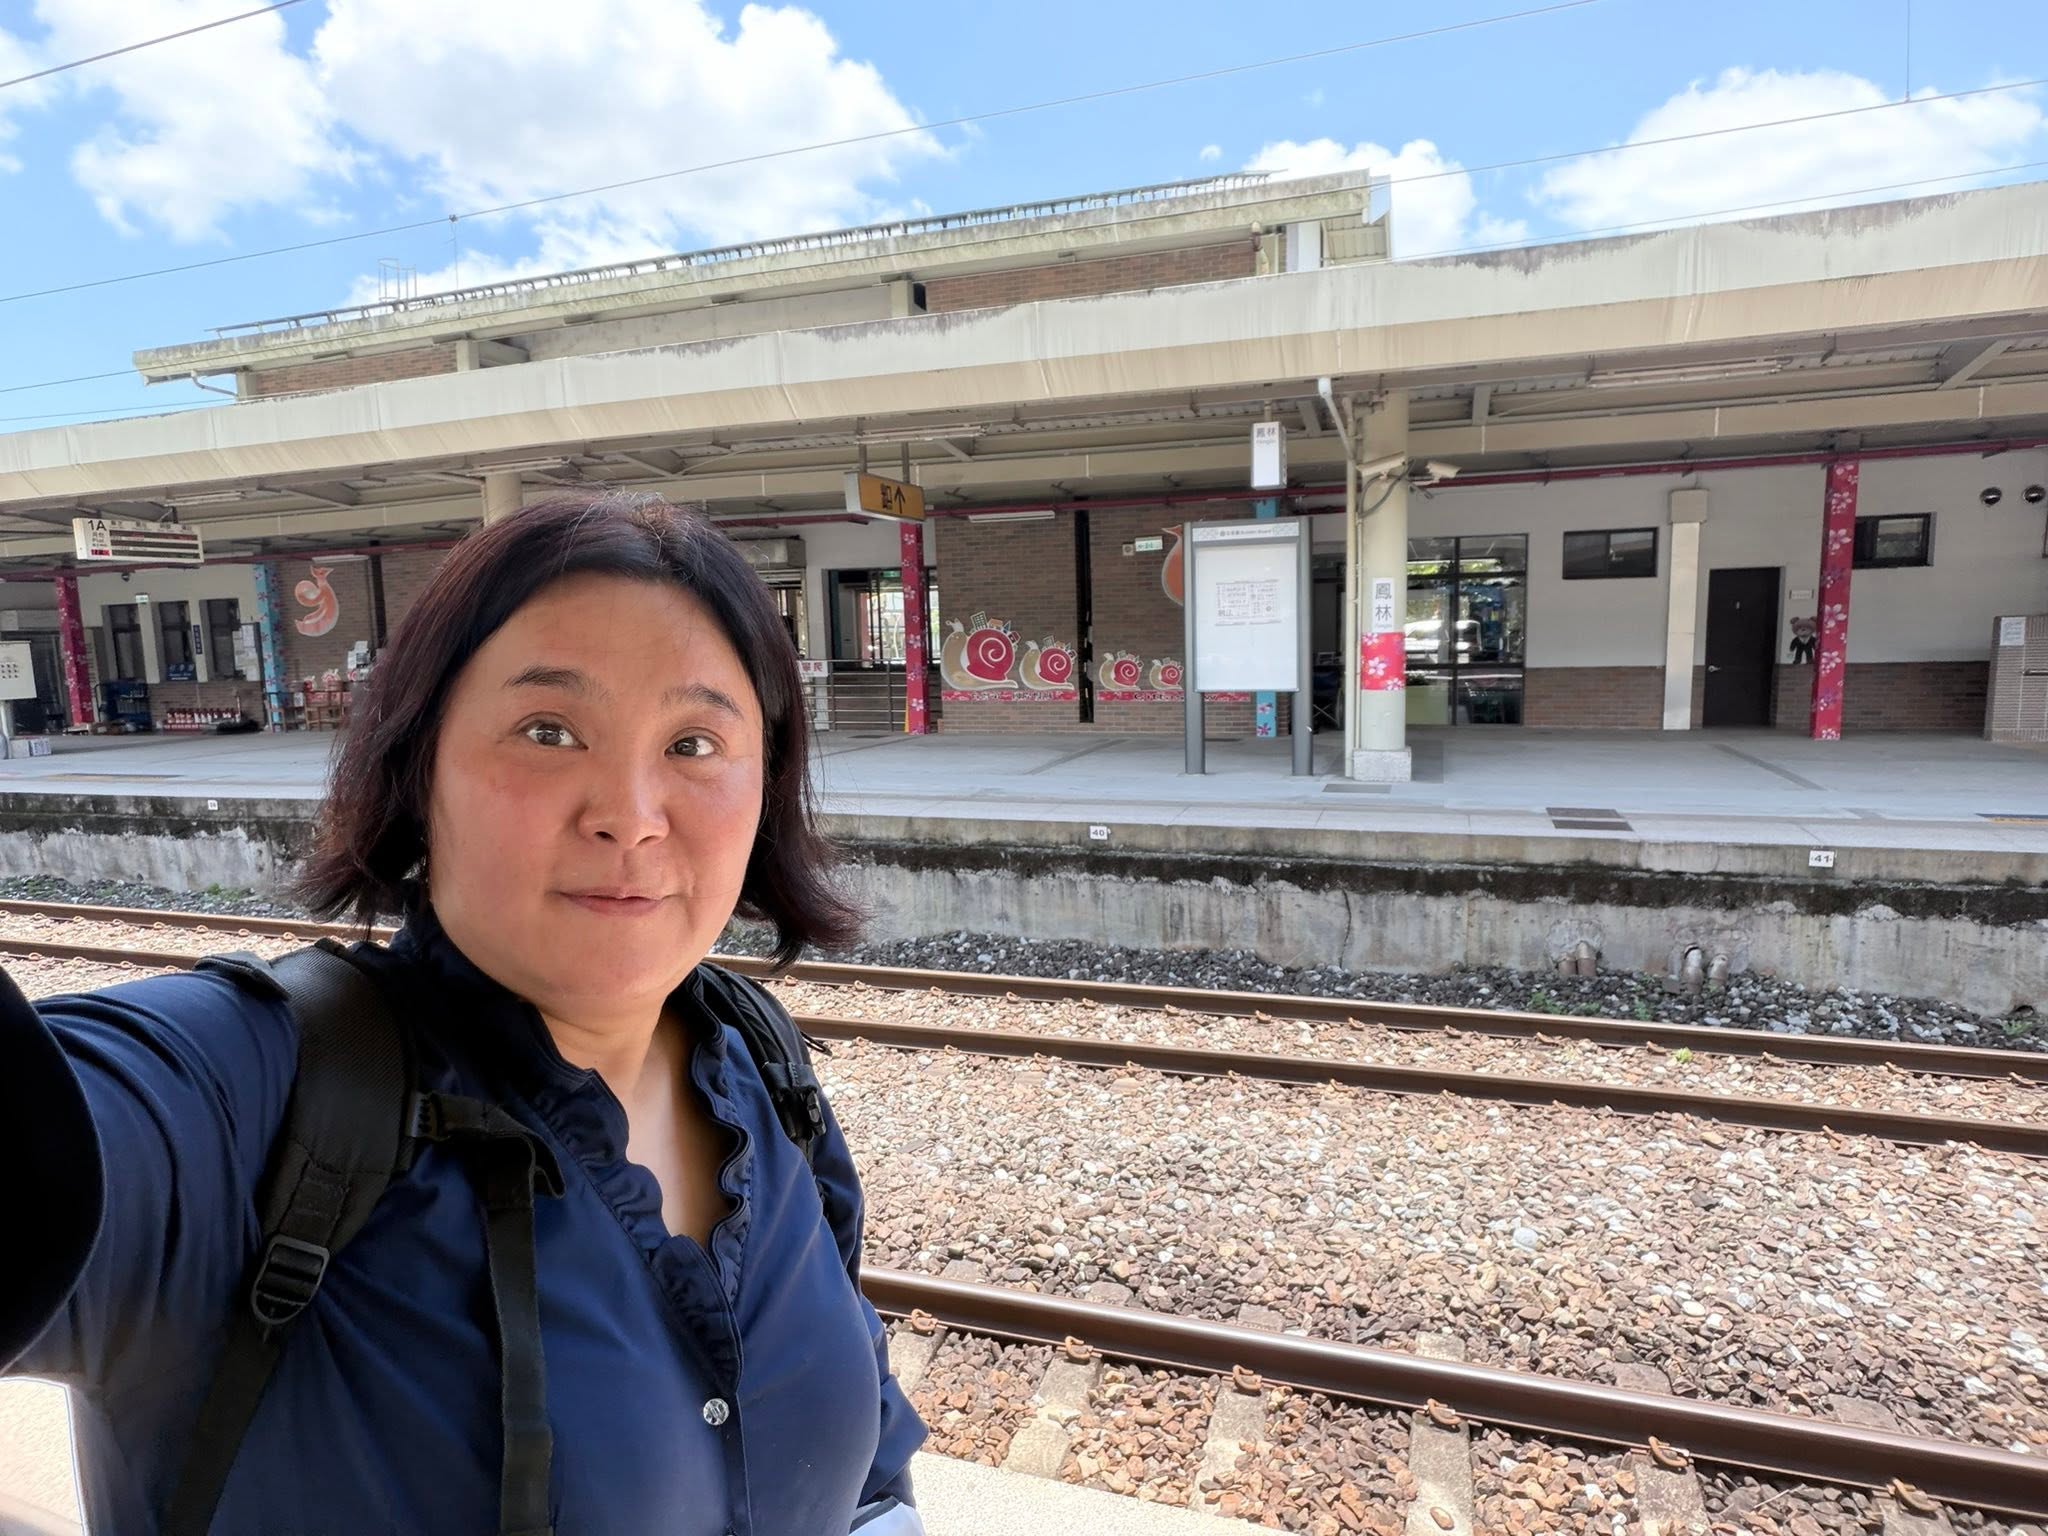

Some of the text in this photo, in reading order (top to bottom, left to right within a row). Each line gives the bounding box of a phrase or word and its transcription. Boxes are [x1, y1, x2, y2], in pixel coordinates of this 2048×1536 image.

[88, 519, 107, 532] 1A
[1375, 582, 1392, 621] 鳳林
[1092, 829, 1105, 837] 40
